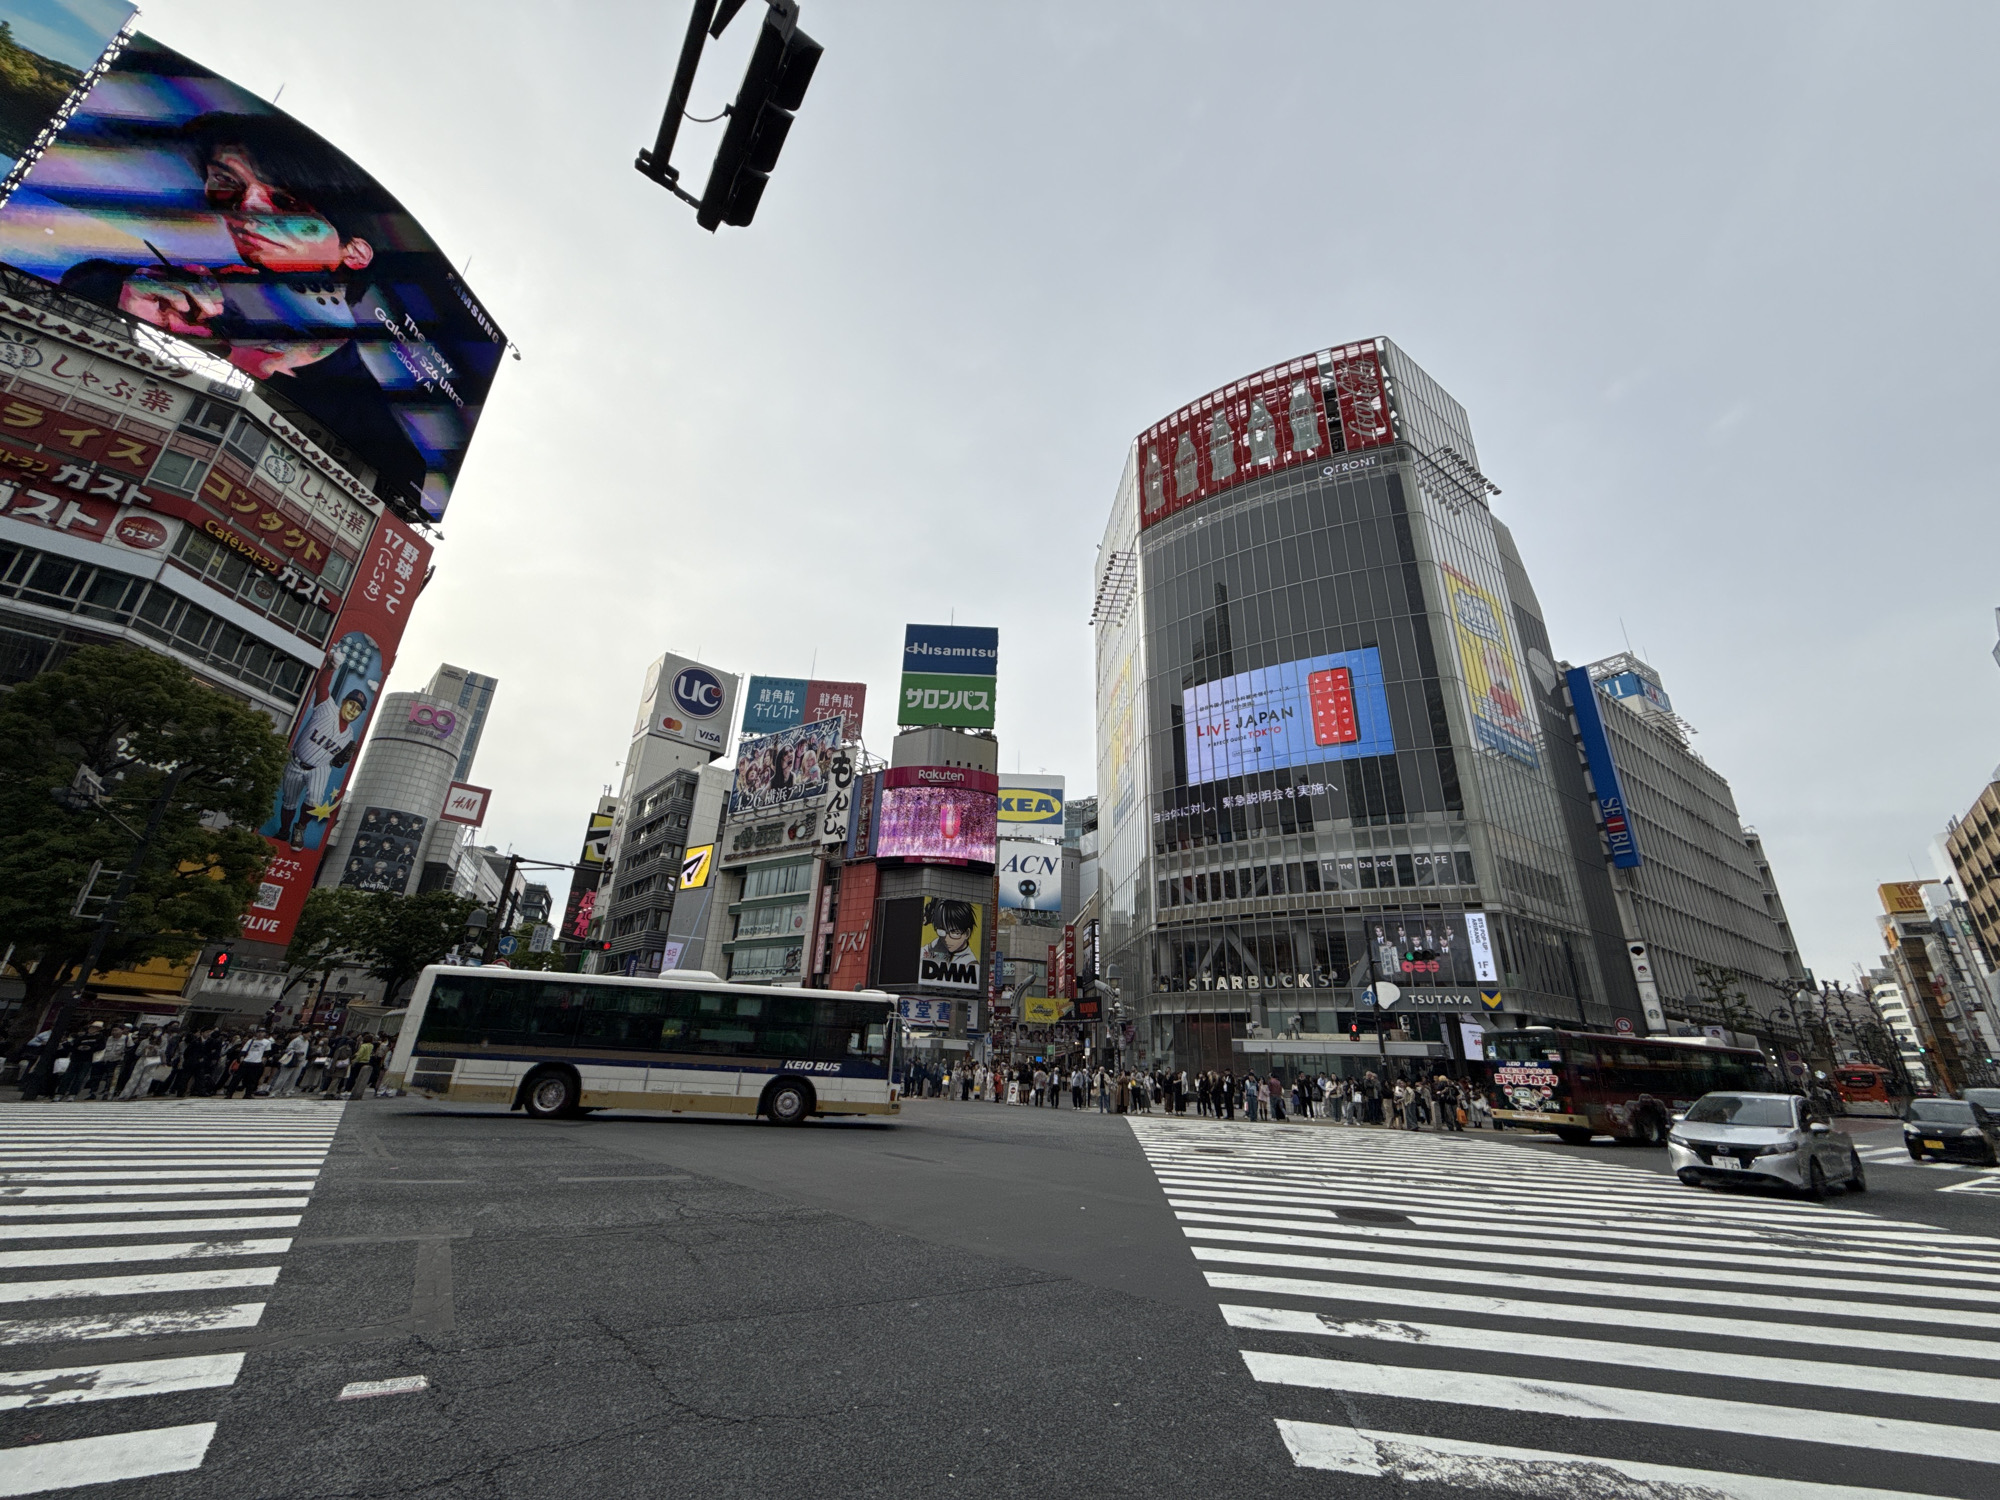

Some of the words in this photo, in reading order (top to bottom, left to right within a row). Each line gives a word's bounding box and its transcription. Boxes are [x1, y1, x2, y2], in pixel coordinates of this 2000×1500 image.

[446, 272, 500, 344] SAMSUNG
[404, 313, 426, 343] The
[427, 344, 453, 374] new
[374, 307, 420, 358] Galaxy
[419, 356, 439, 381] S26
[439, 376, 465, 409] Ultra
[389, 341, 424, 383] Galaxy
[51, 353, 174, 413] しゃぶ葉
[269, 412, 380, 507] しゃぶしゃぶバイキング
[1323, 455, 1376, 476] QFRONT
[52, 463, 152, 505] ガスト
[203, 470, 323, 561] コンタクト
[301, 473, 367, 535] しゃぶ葉
[121, 527, 161, 543] ガスト
[277, 566, 331, 606] ガスト
[384, 541, 420, 615] 野球って
[905, 642, 997, 658] Hisamitsu
[759, 688, 796, 704] 龍角散
[818, 692, 855, 708] 龍角散
[905, 688, 990, 711] サロンパス
[408, 700, 457, 740] 109
[752, 703, 800, 719] ダイレクト
[1197, 719, 1231, 738] LIVE
[1235, 705, 1294, 729] JAPAN
[698, 729, 721, 743] VISA
[1248, 726, 1282, 739] TOKYO
[918, 769, 965, 781] Rakuten
[452, 795, 477, 812] H&M
[765, 778, 828, 806] 横浜アリーナ
[823, 750, 852, 841] もんじゃ
[1223, 782, 1339, 809] 緊急説明会を実施へ
[1601, 797, 1633, 856] SEIBU
[1000, 854, 1061, 875] ACN
[1414, 855, 1448, 866] CAFE
[1471, 918, 1481, 944] ARIRANG
[833, 919, 870, 973] クスリ
[1065, 930, 1074, 970] カラオケ
[921, 959, 978, 985] DMM
[1477, 961, 1489, 969] 1F
[1188, 973, 1330, 991] STARBUCKS
[1409, 995, 1473, 1004] TSUTAYA
[784, 1060, 814, 1070] KEIO
[815, 1061, 841, 1071] BUS
[1494, 1073, 1559, 1086] ヨドバシカメラ
